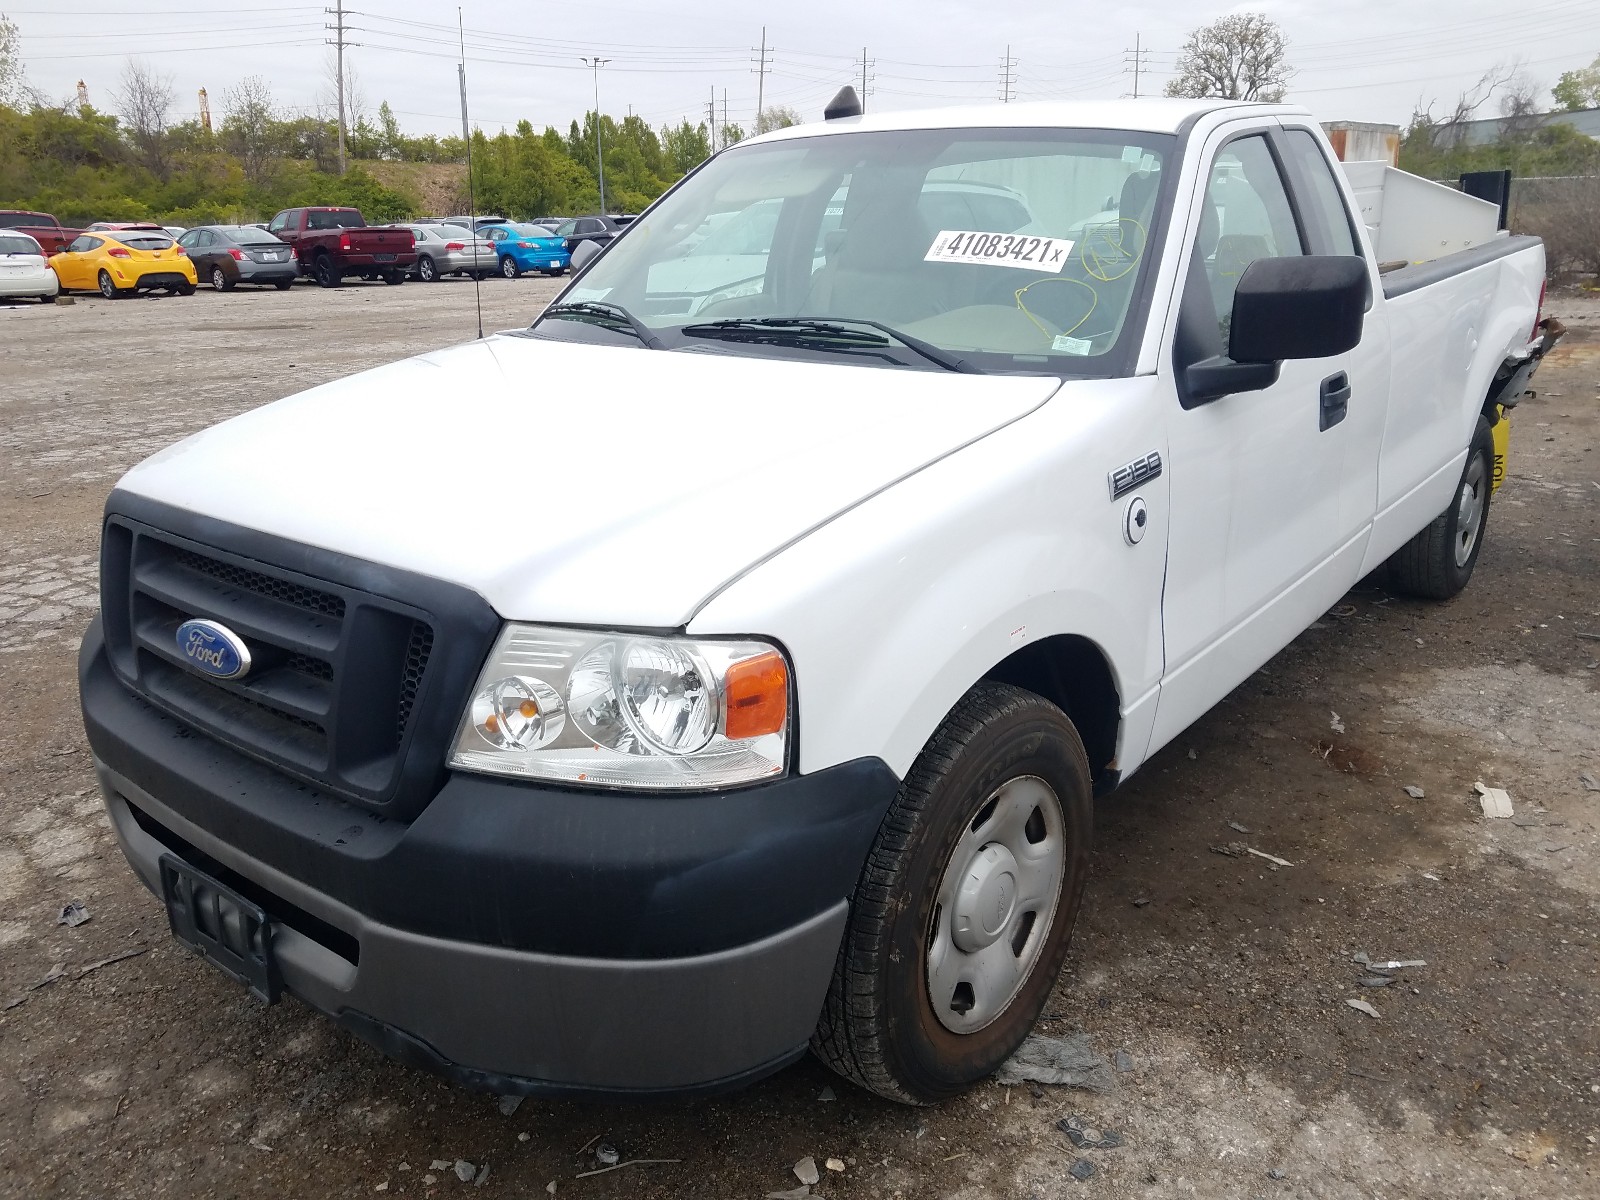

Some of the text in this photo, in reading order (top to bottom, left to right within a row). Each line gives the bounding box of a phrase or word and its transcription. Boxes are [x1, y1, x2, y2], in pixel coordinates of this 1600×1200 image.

[947, 233, 1053, 263] 41083421
[1112, 451, 1162, 492] F-150
[186, 629, 224, 668] Ford
